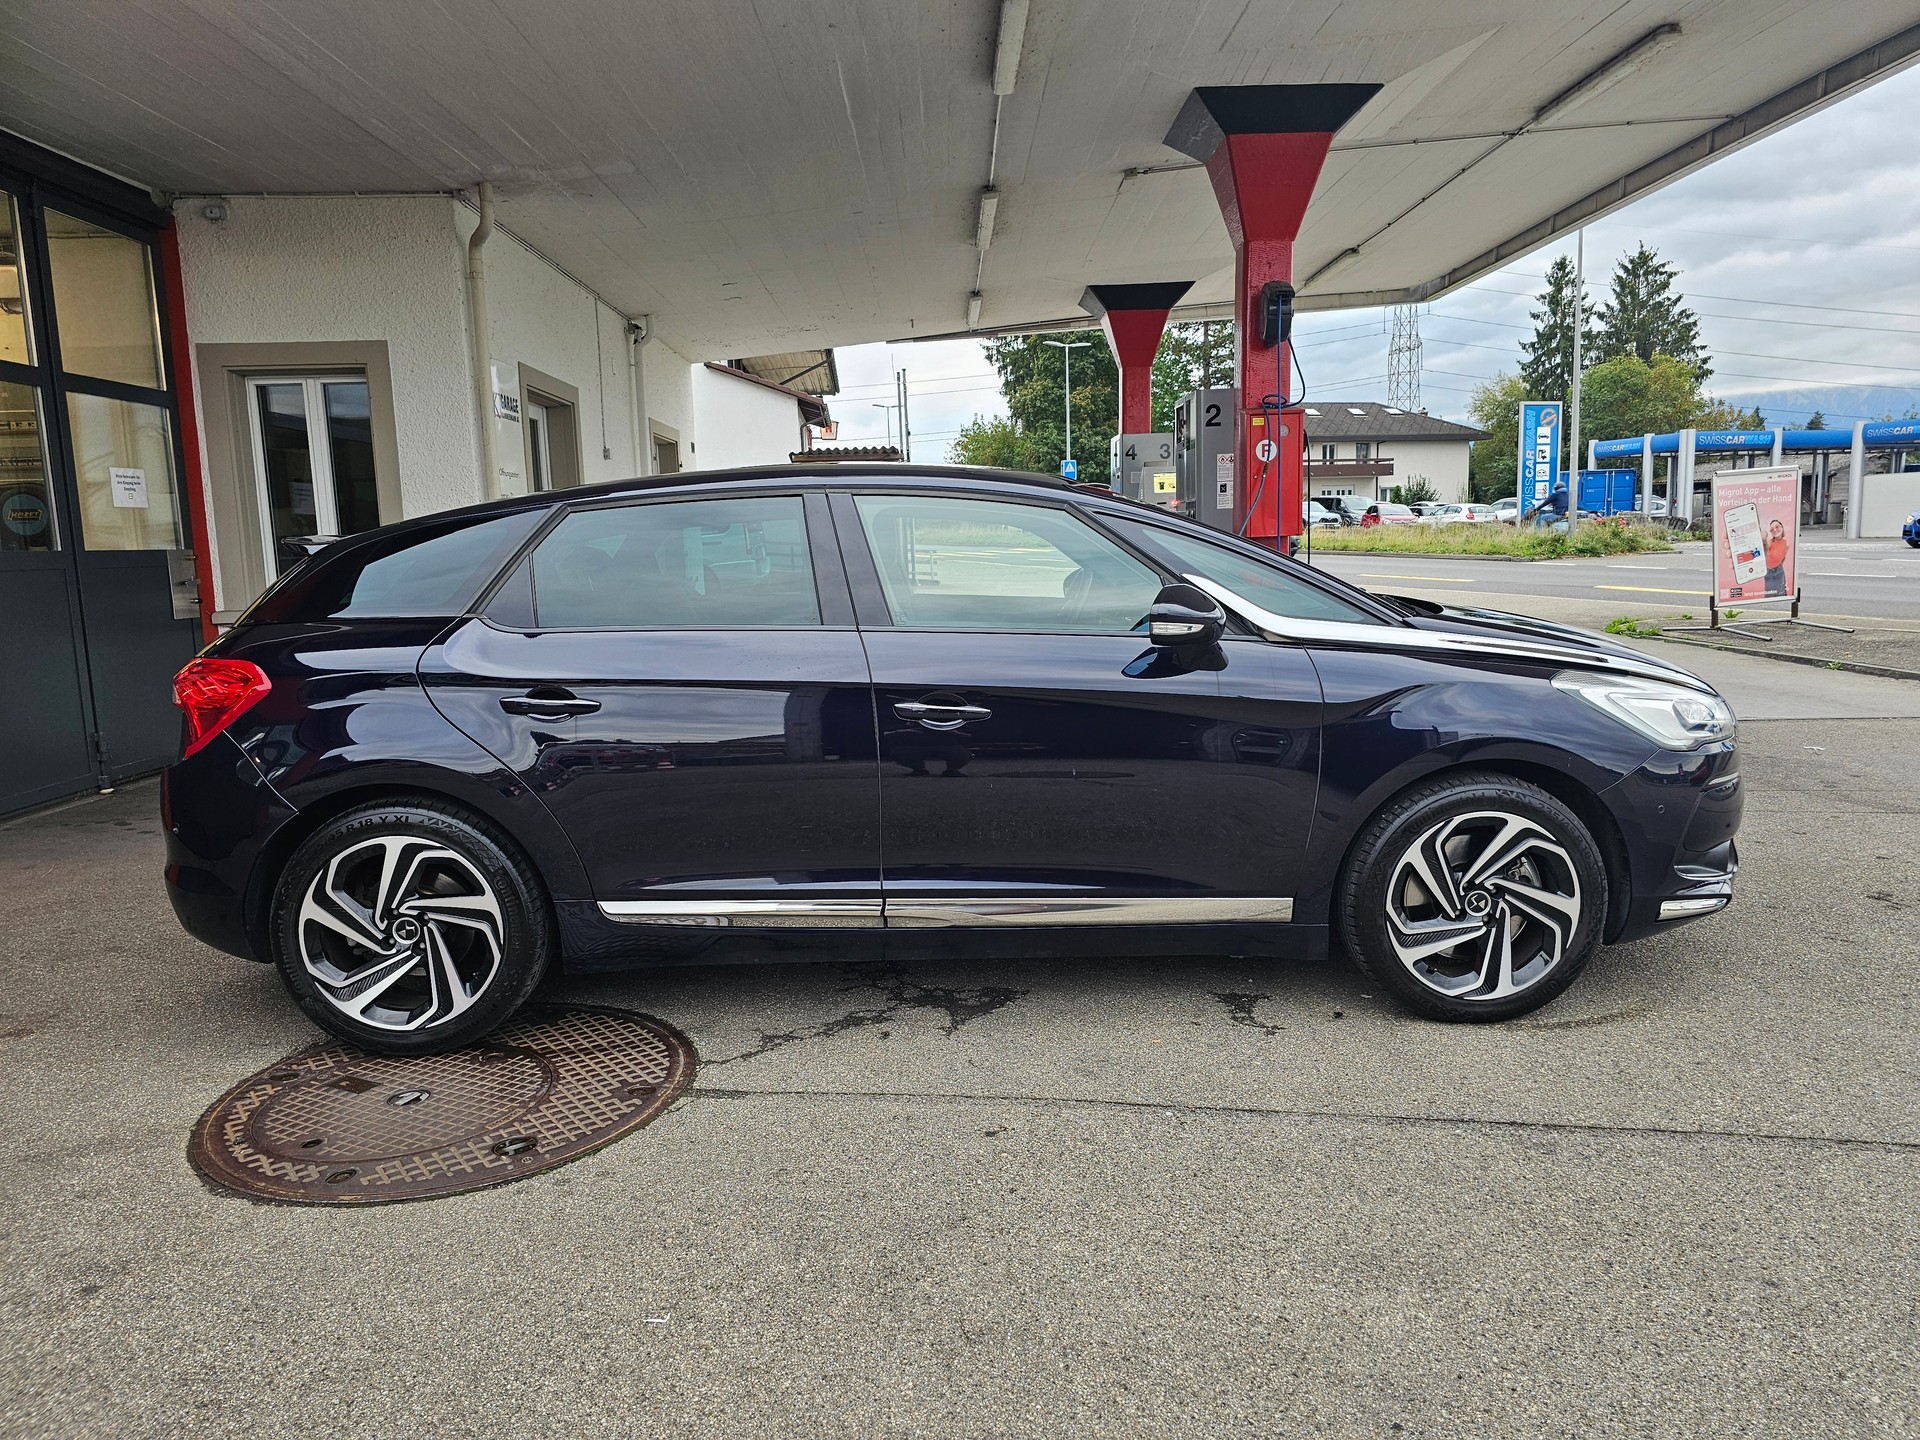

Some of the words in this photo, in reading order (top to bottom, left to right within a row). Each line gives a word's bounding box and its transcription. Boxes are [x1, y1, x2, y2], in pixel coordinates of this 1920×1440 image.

[1205, 404, 1221, 427] 2
[1125, 444, 1137, 460] 4
[1159, 443, 1171, 460] 3
[1718, 488, 1743, 498] Migrol
[1744, 487, 1760, 496] App
[1757, 496, 1771, 504] der
[1772, 494, 1792, 503] Hand
[10, 510, 41, 520] HAZET
[345, 824, 356, 833] R
[358, 818, 374, 828] 18
[379, 815, 389, 824] Y
